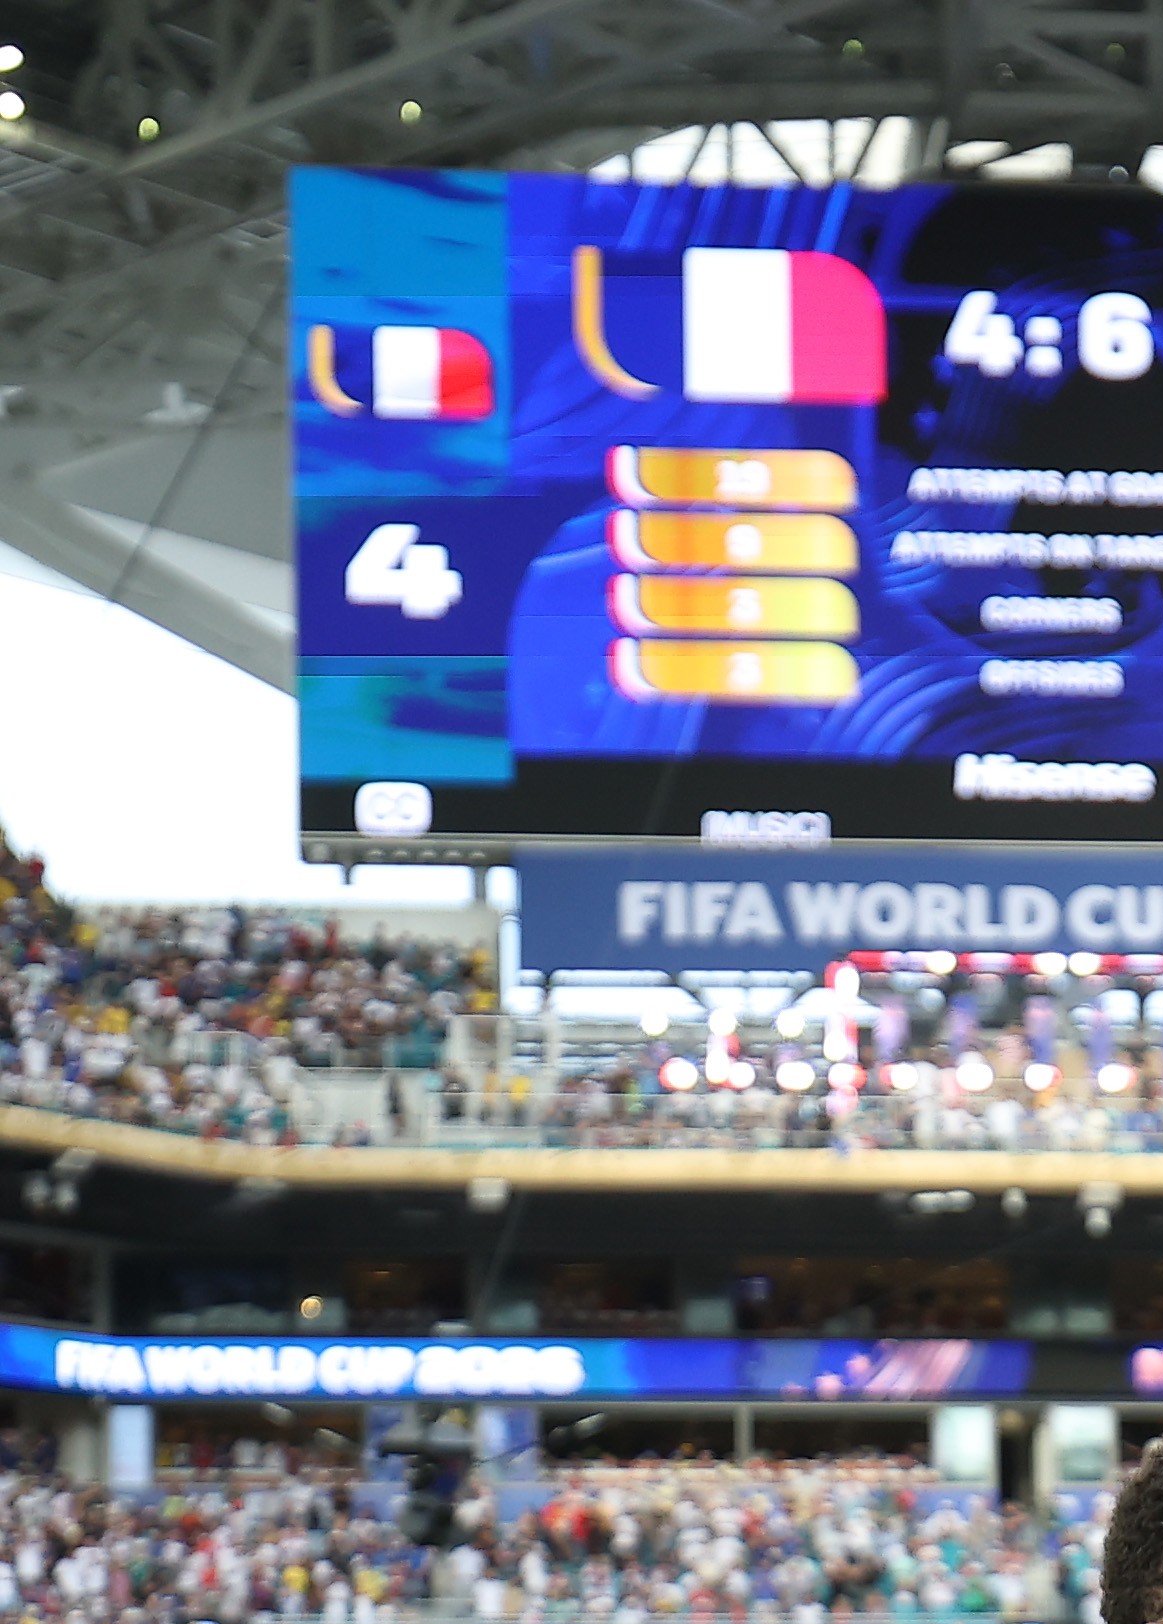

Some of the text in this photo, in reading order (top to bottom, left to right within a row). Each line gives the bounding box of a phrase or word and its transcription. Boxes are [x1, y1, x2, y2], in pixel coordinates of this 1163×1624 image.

[907, 468, 1064, 506] ATTEMPTS
[1064, 471, 1108, 505] AT
[345, 523, 463, 619] 4
[890, 531, 1048, 569] ATTEMPTS
[980, 596, 1123, 634] CORNERS
[979, 659, 1125, 697] OFFSIDES
[953, 753, 1158, 801] Hisense
[617, 879, 787, 946] FIFA
[785, 880, 1060, 948] WORLD
[55, 1338, 148, 1393] FIFA
[144, 1344, 318, 1396] WORLD
[318, 1345, 415, 1397] CUP
